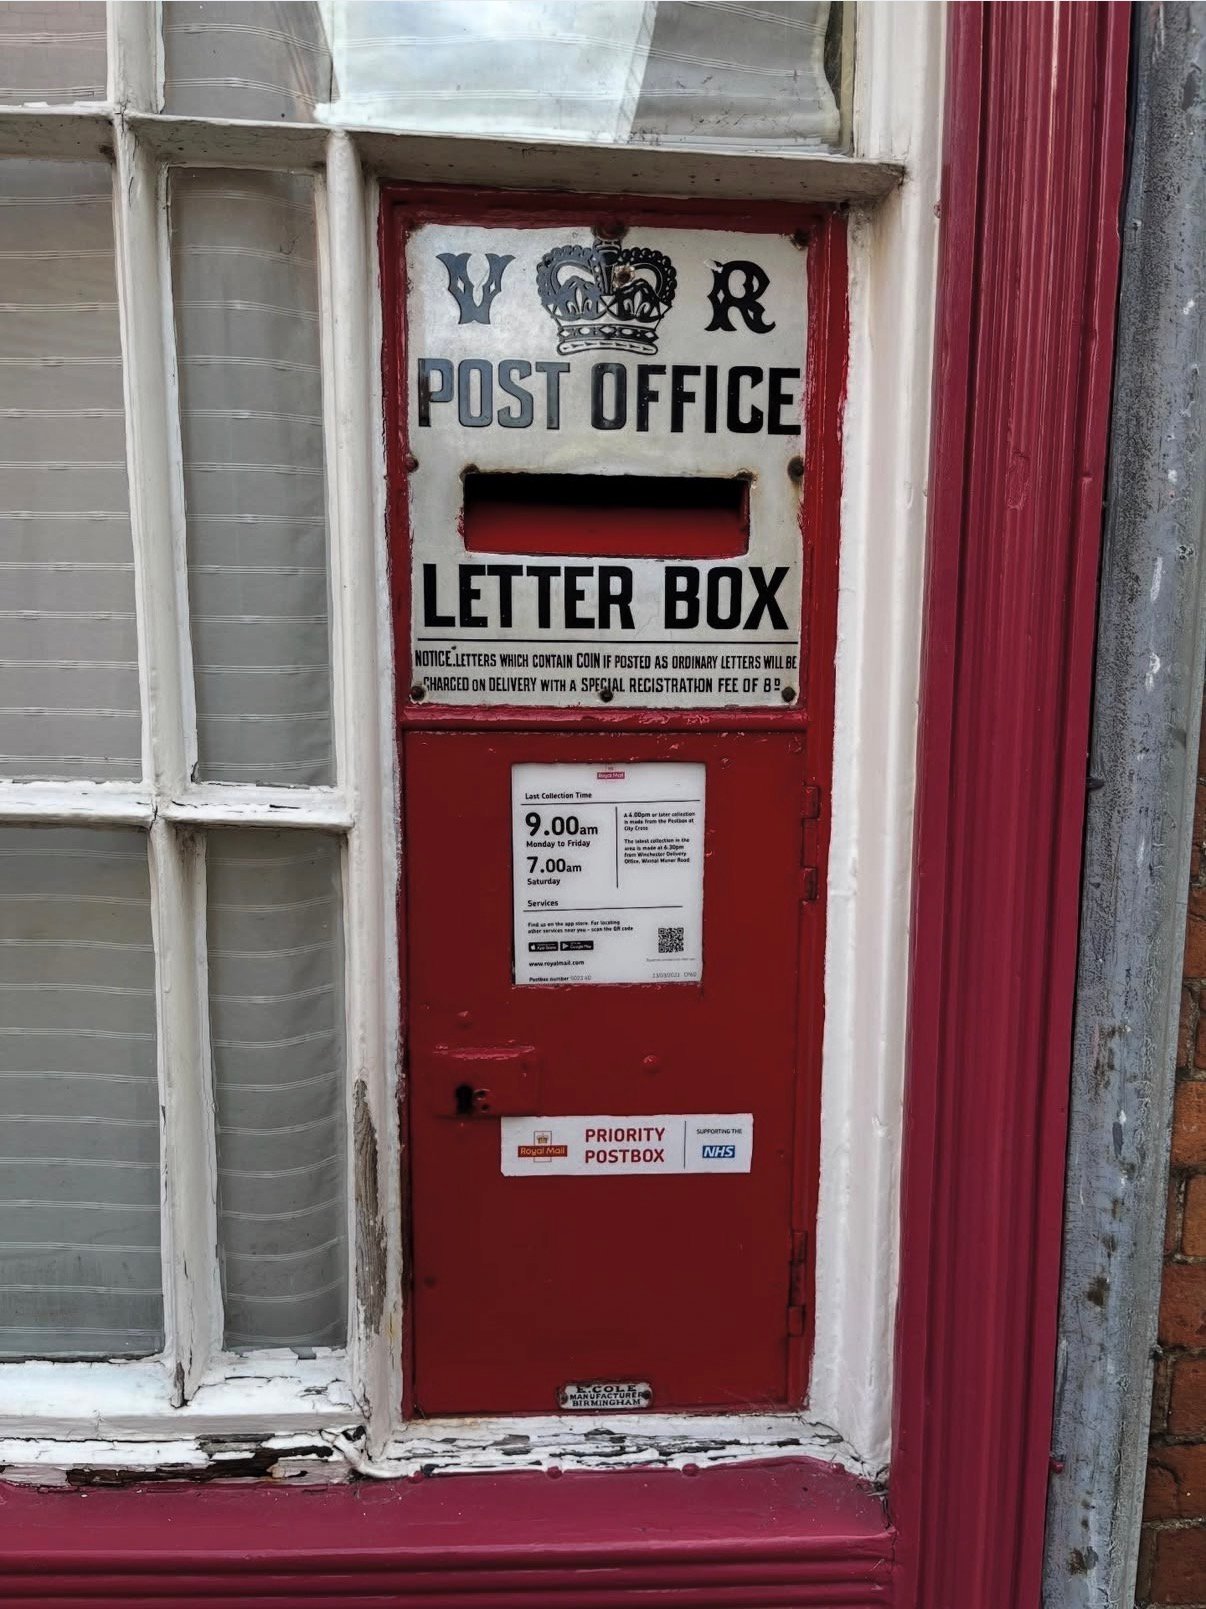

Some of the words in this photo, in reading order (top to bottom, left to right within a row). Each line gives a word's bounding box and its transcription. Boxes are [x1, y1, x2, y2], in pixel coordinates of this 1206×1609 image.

[436, 252, 515, 324] V
[704, 260, 776, 334] R
[418, 358, 570, 430] POST
[591, 363, 801, 435] OFFICE
[423, 563, 635, 629] LETTER
[665, 566, 790, 630] BOX
[500, 654, 528, 668] WHICH
[532, 654, 573, 669] CONTAIN
[576, 652, 600, 669] COIN
[603, 655, 611, 669] IF
[615, 655, 651, 669] POSTED
[655, 656, 668, 669] AS
[672, 656, 718, 669] ORDINARY
[721, 656, 761, 669] LETTERS
[763, 656, 784, 669] WILL
[786, 656, 797, 669] BE
[423, 677, 469, 692] CHARGED
[472, 679, 485, 692] ON
[489, 677, 537, 692] DELIVERY
[541, 679, 566, 692] WITH
[569, 680, 576, 692] A
[581, 677, 625, 692] SPECIAL
[629, 677, 712, 693] REGISTRATION
[718, 678, 738, 692] FEE
[743, 678, 758, 692] OF
[525, 812, 598, 836] 9.00am
[567, 840, 591, 848] Friday
[527, 856, 582, 873] 7.00am
[527, 878, 560, 886] Saturday
[585, 1127, 665, 1142] PRIORITY
[520, 1147, 545, 1156] Royal
[546, 1147, 565, 1155] Mail
[585, 1149, 664, 1163] POSTBOX
[703, 1146, 734, 1158] NHS
[572, 1399, 640, 1407] BIRMINGHAM
